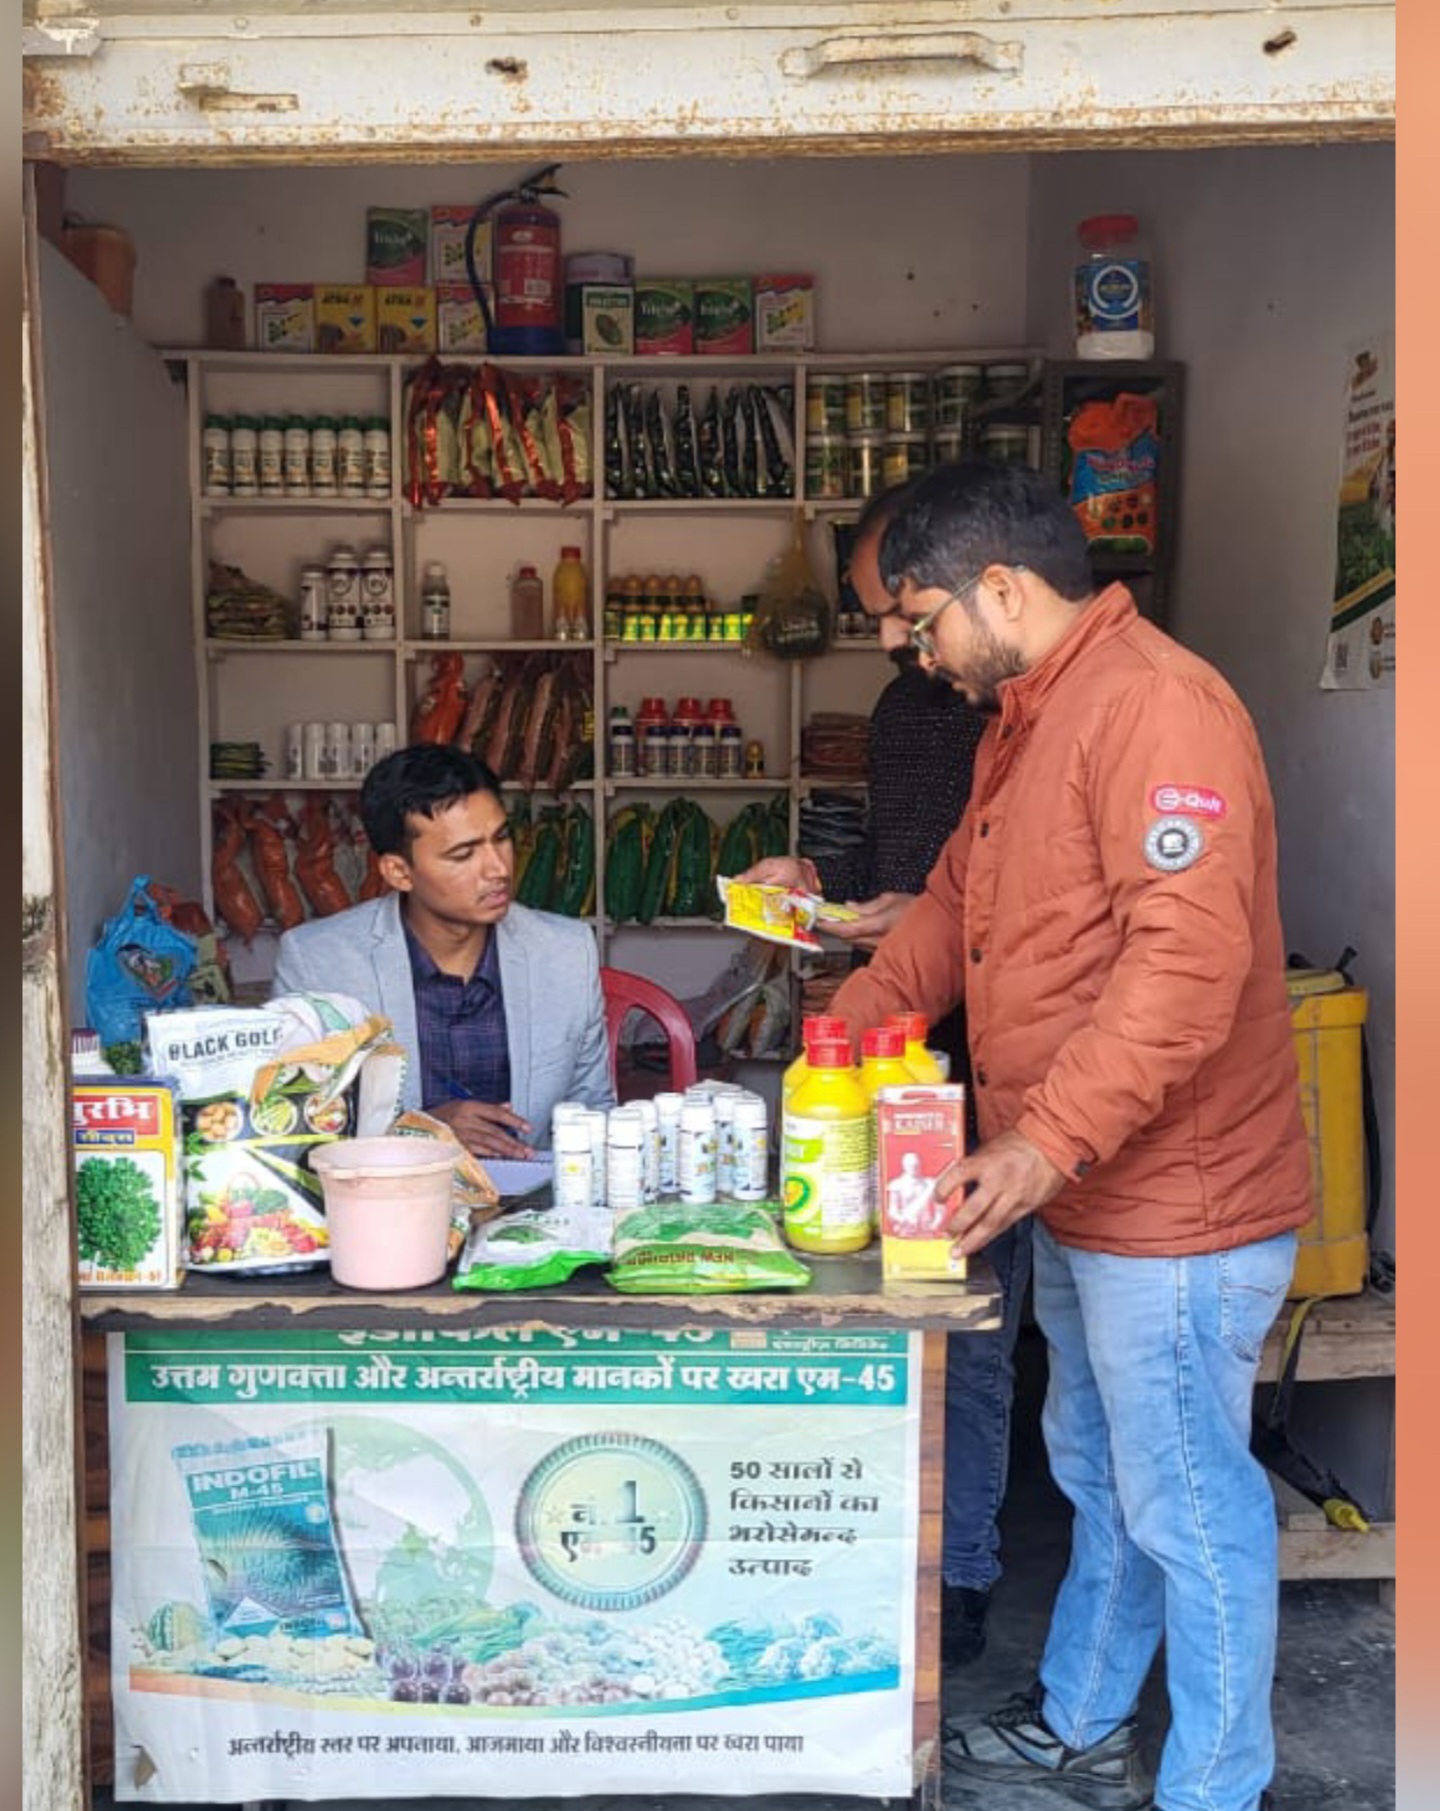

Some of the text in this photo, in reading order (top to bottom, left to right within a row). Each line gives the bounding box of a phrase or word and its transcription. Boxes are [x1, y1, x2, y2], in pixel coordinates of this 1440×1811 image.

[168, 1034, 229, 1061] BLACK
[151, 1364, 221, 1389] उत्तम
[227, 1364, 347, 1399] गुणवत्ता
[354, 1354, 407, 1389] और
[572, 1354, 676, 1390] मानकों
[681, 1365, 720, 1390] पर
[726, 1365, 790, 1391] खरा
[796, 1364, 896, 1395] एम-45
[192, 1462, 317, 1493] INDOFIL
[729, 1456, 864, 1480] 50 सालों से
[231, 1483, 284, 1500] M-45
[616, 1479, 646, 1524] 1
[729, 1488, 880, 1513] किसानों का
[728, 1520, 858, 1545] भरोसेमन्द
[727, 1556, 814, 1577] उत्पाद
[320, 1735, 354, 1754] स्तर
[358, 1735, 381, 1753] पर
[466, 1735, 544, 1754] आजमाया
[550, 1729, 580, 1753] और
[696, 1734, 719, 1752] पर
[724, 1734, 760, 1752] खरा
[763, 1734, 804, 1753] पाया
